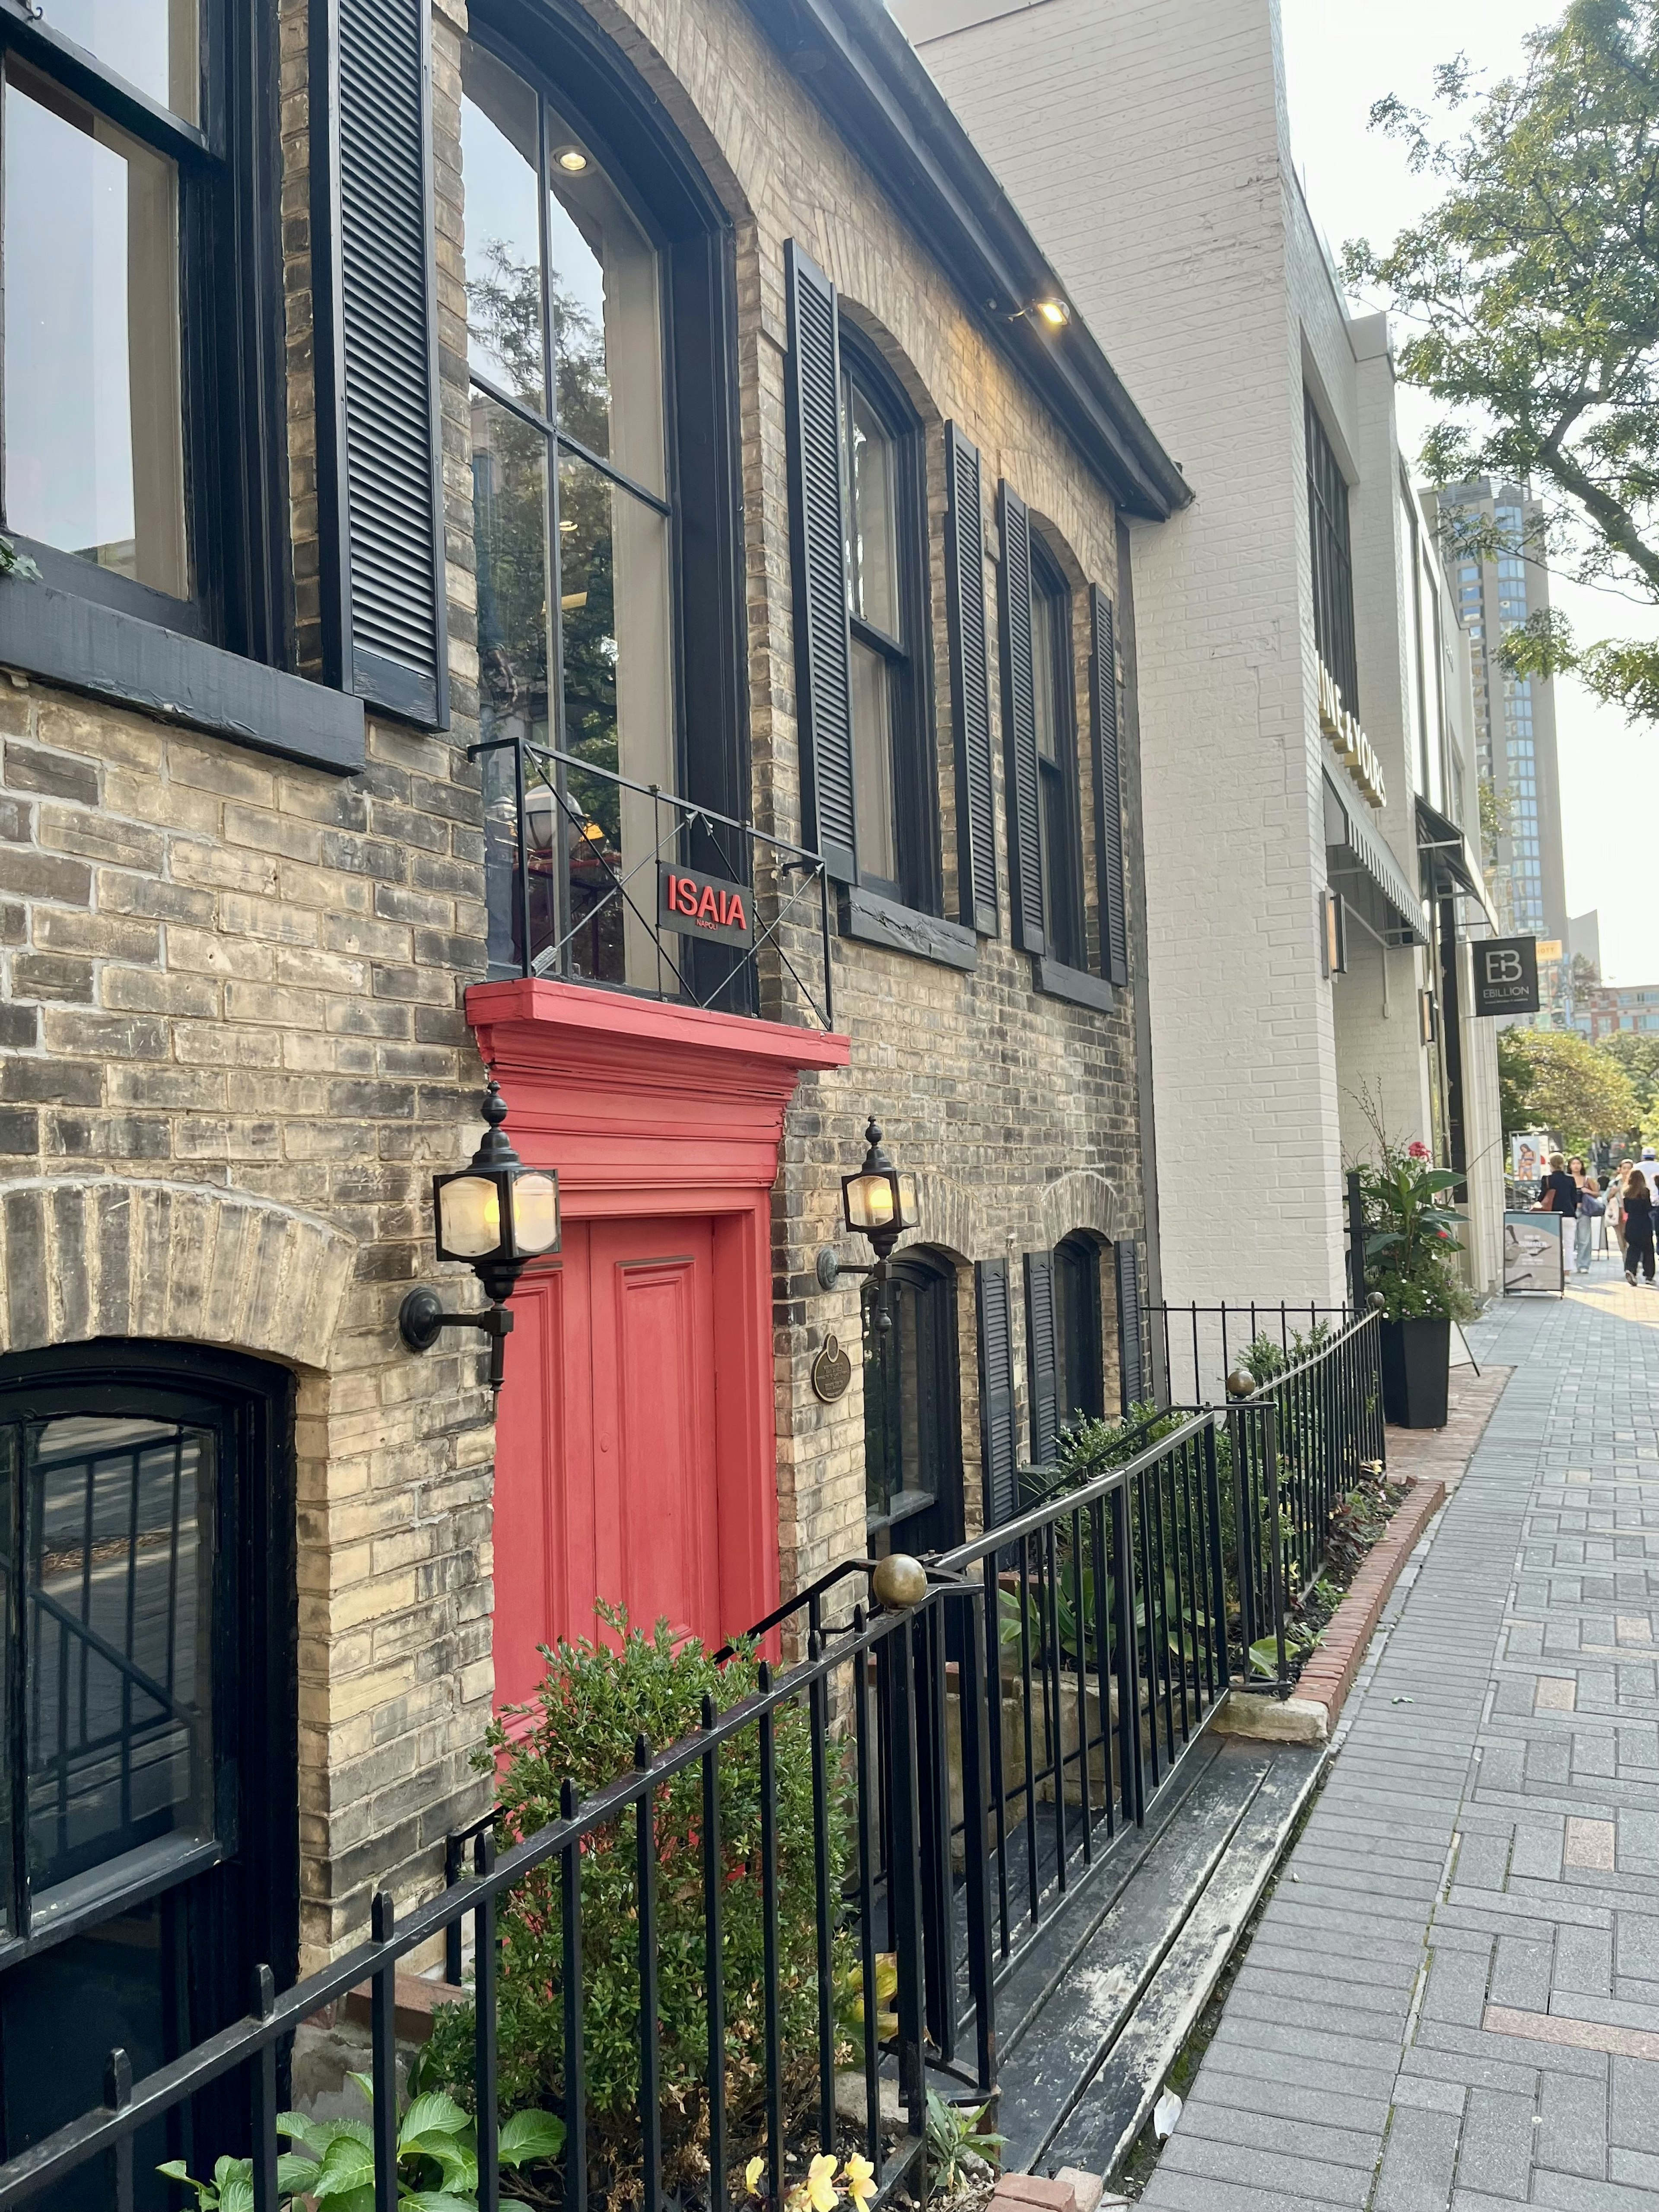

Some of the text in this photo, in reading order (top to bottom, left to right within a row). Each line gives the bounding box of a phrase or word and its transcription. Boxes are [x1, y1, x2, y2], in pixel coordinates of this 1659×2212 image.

[1352, 717, 1387, 807] YOURS
[668, 875, 747, 929] ISAIA
[696, 919, 718, 931] NAPOLI
[1483, 986, 1529, 998] EBILLION
